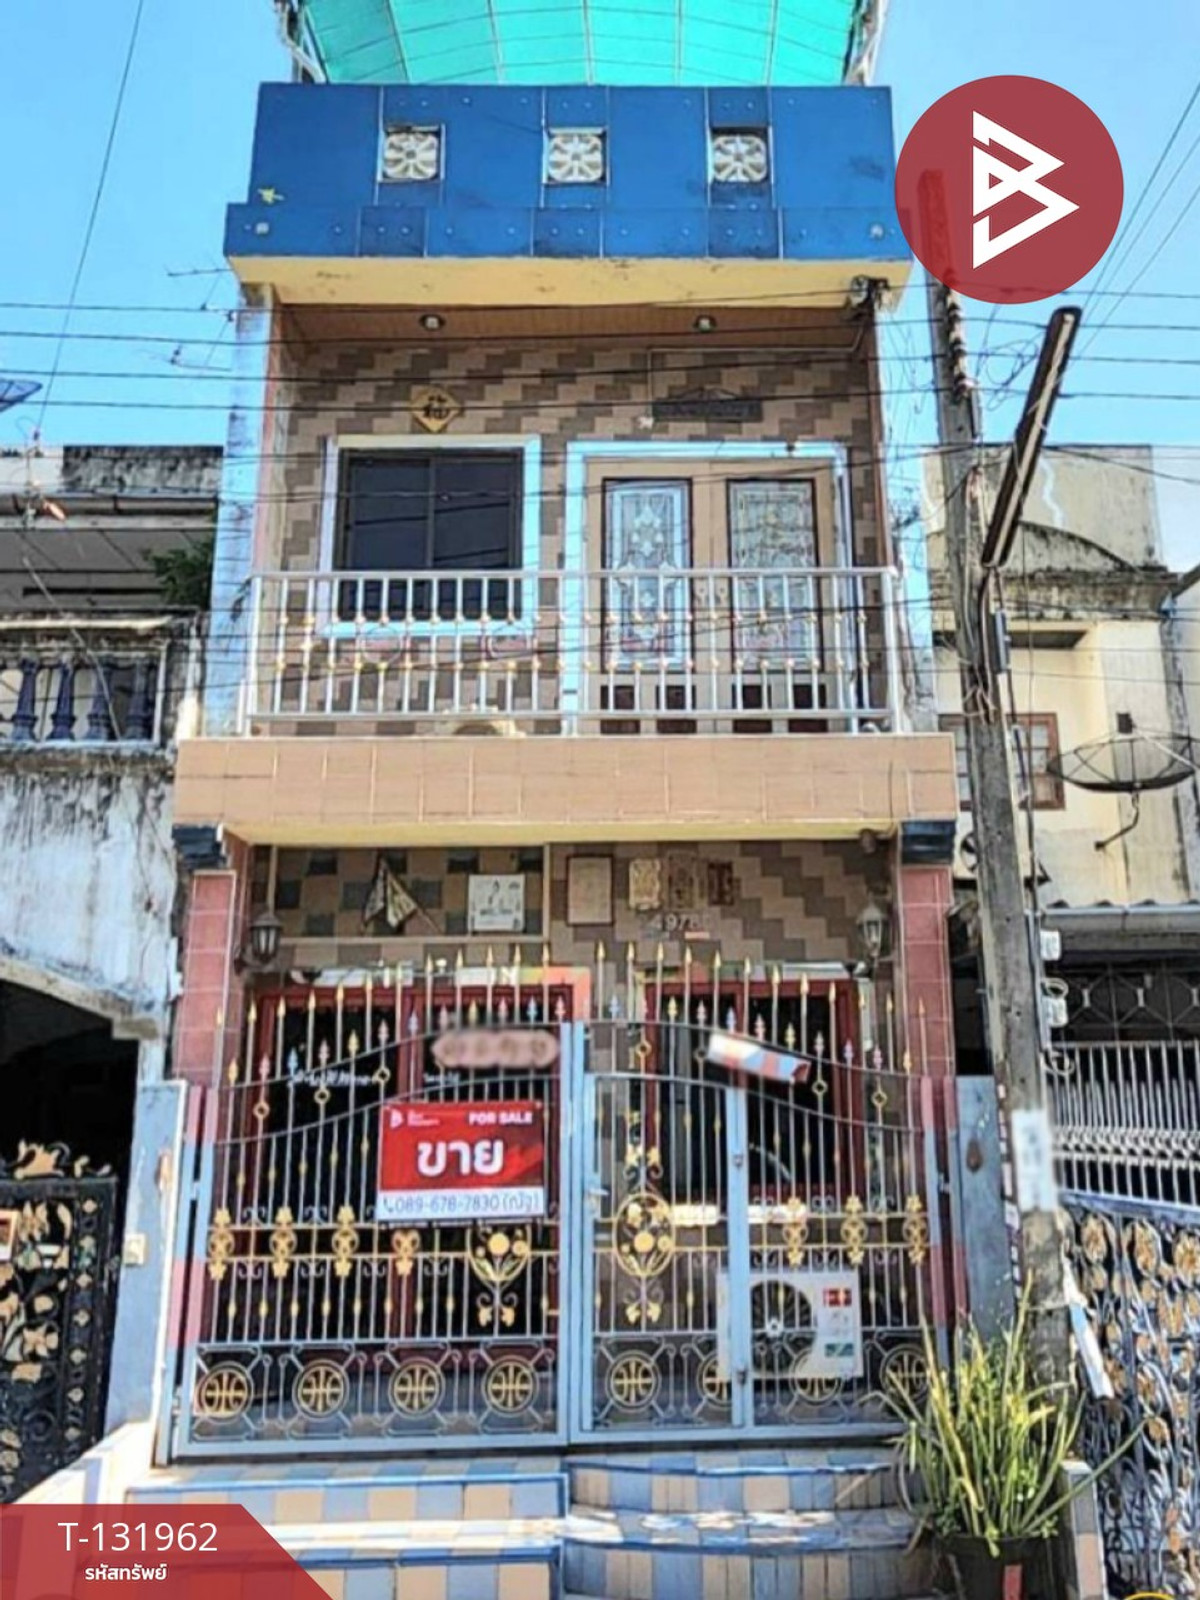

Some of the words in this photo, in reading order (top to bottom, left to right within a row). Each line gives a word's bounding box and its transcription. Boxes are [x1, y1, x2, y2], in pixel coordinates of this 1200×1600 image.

[468, 1110, 497, 1125] FOR
[499, 1111, 533, 1125] SALE
[416, 1138, 505, 1177] ขาย
